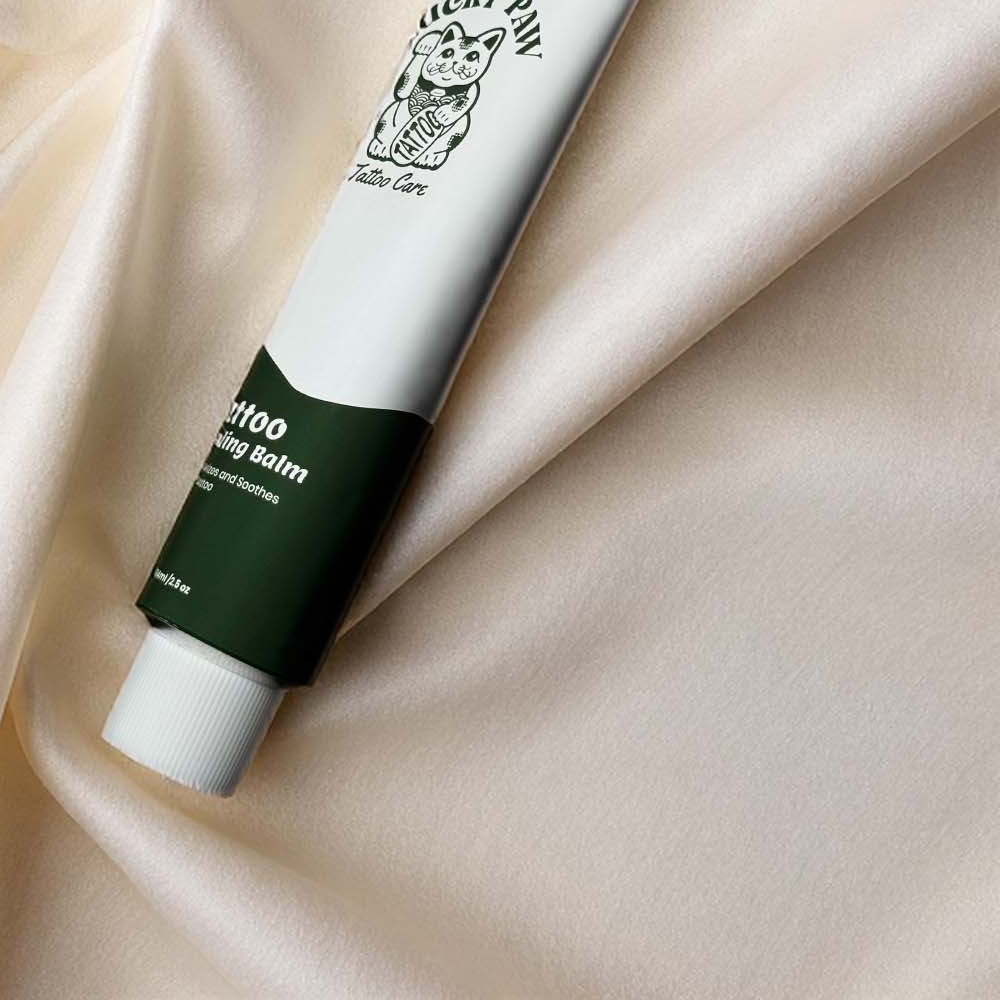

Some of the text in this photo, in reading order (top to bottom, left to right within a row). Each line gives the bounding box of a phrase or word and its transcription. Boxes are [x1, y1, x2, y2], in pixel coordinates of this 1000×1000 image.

[348, 163, 429, 196] Tattoo Care
[249, 444, 309, 484] Balm
[218, 470, 239, 485] and
[236, 476, 280, 505] Soothes
[180, 583, 191, 595] oz
